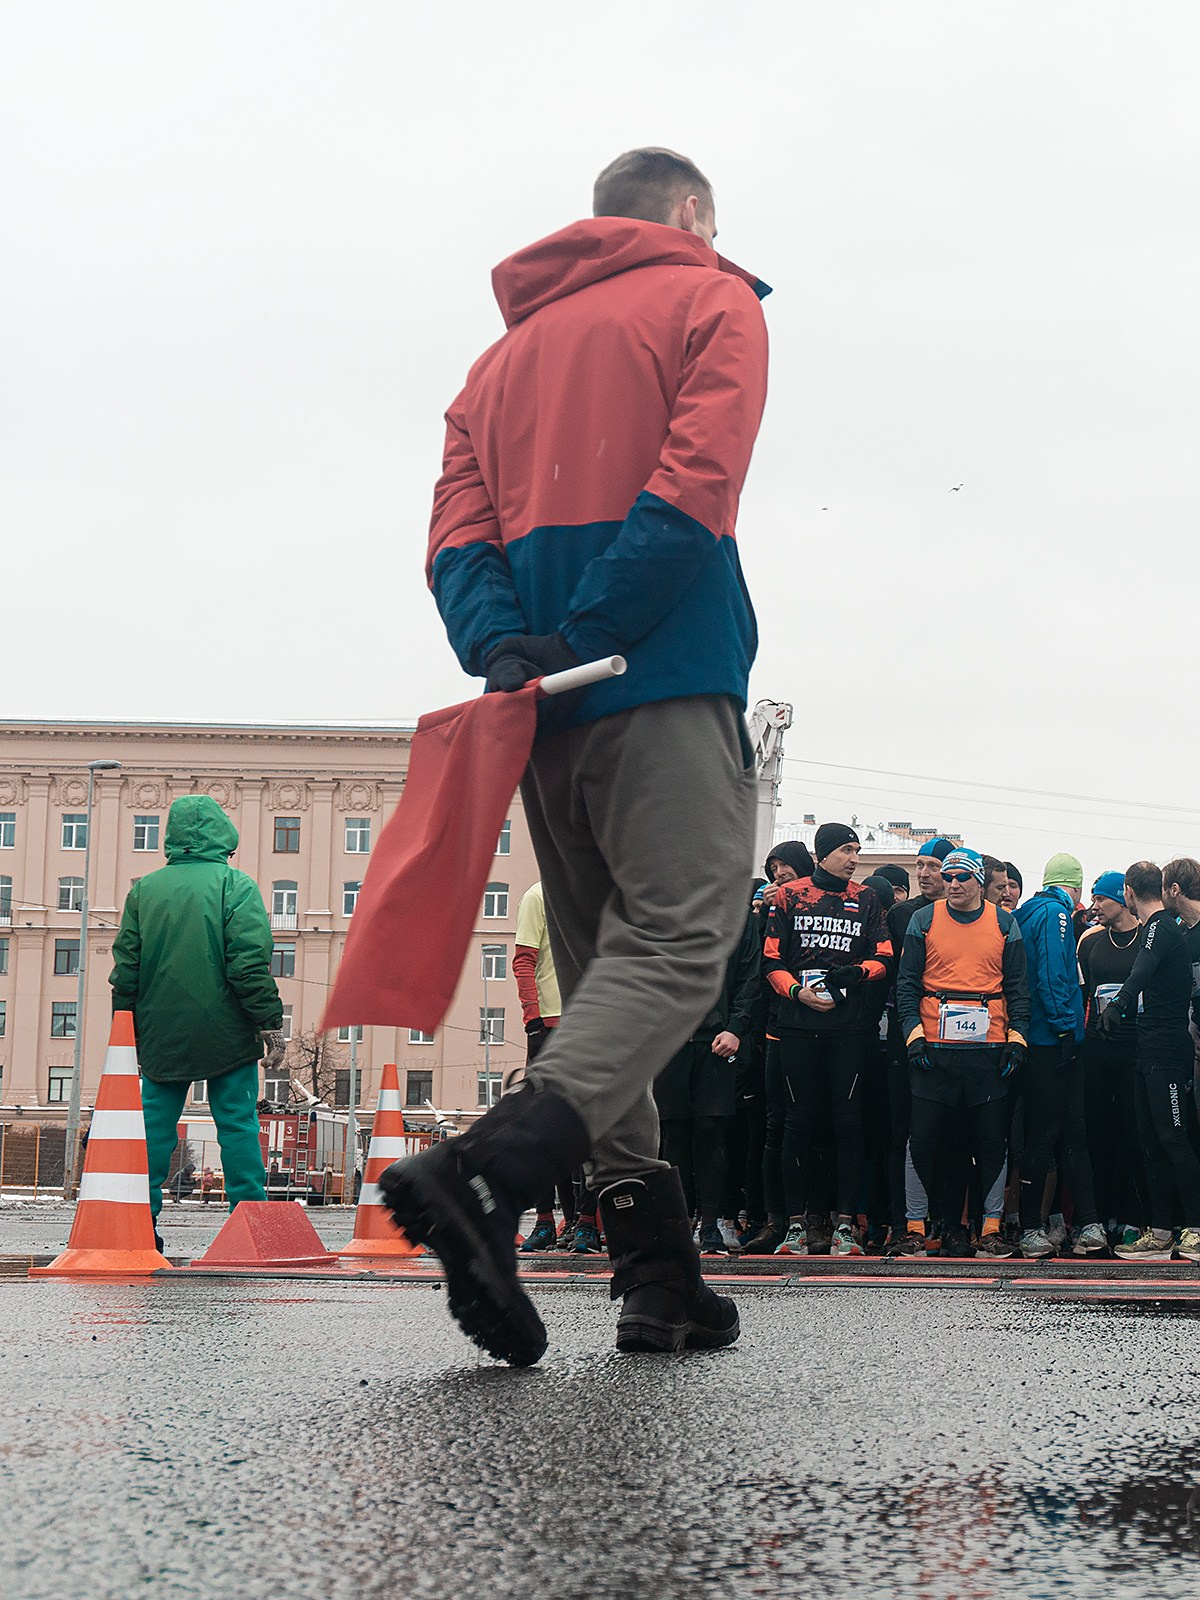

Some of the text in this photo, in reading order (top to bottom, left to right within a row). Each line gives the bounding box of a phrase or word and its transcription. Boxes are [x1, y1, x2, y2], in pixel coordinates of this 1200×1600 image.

[794, 916, 862, 936] КРЕПКАЯ
[800, 933, 852, 952] БРОНЯ
[955, 1020, 977, 1031] 144
[286, 1126, 293, 1134] 3
